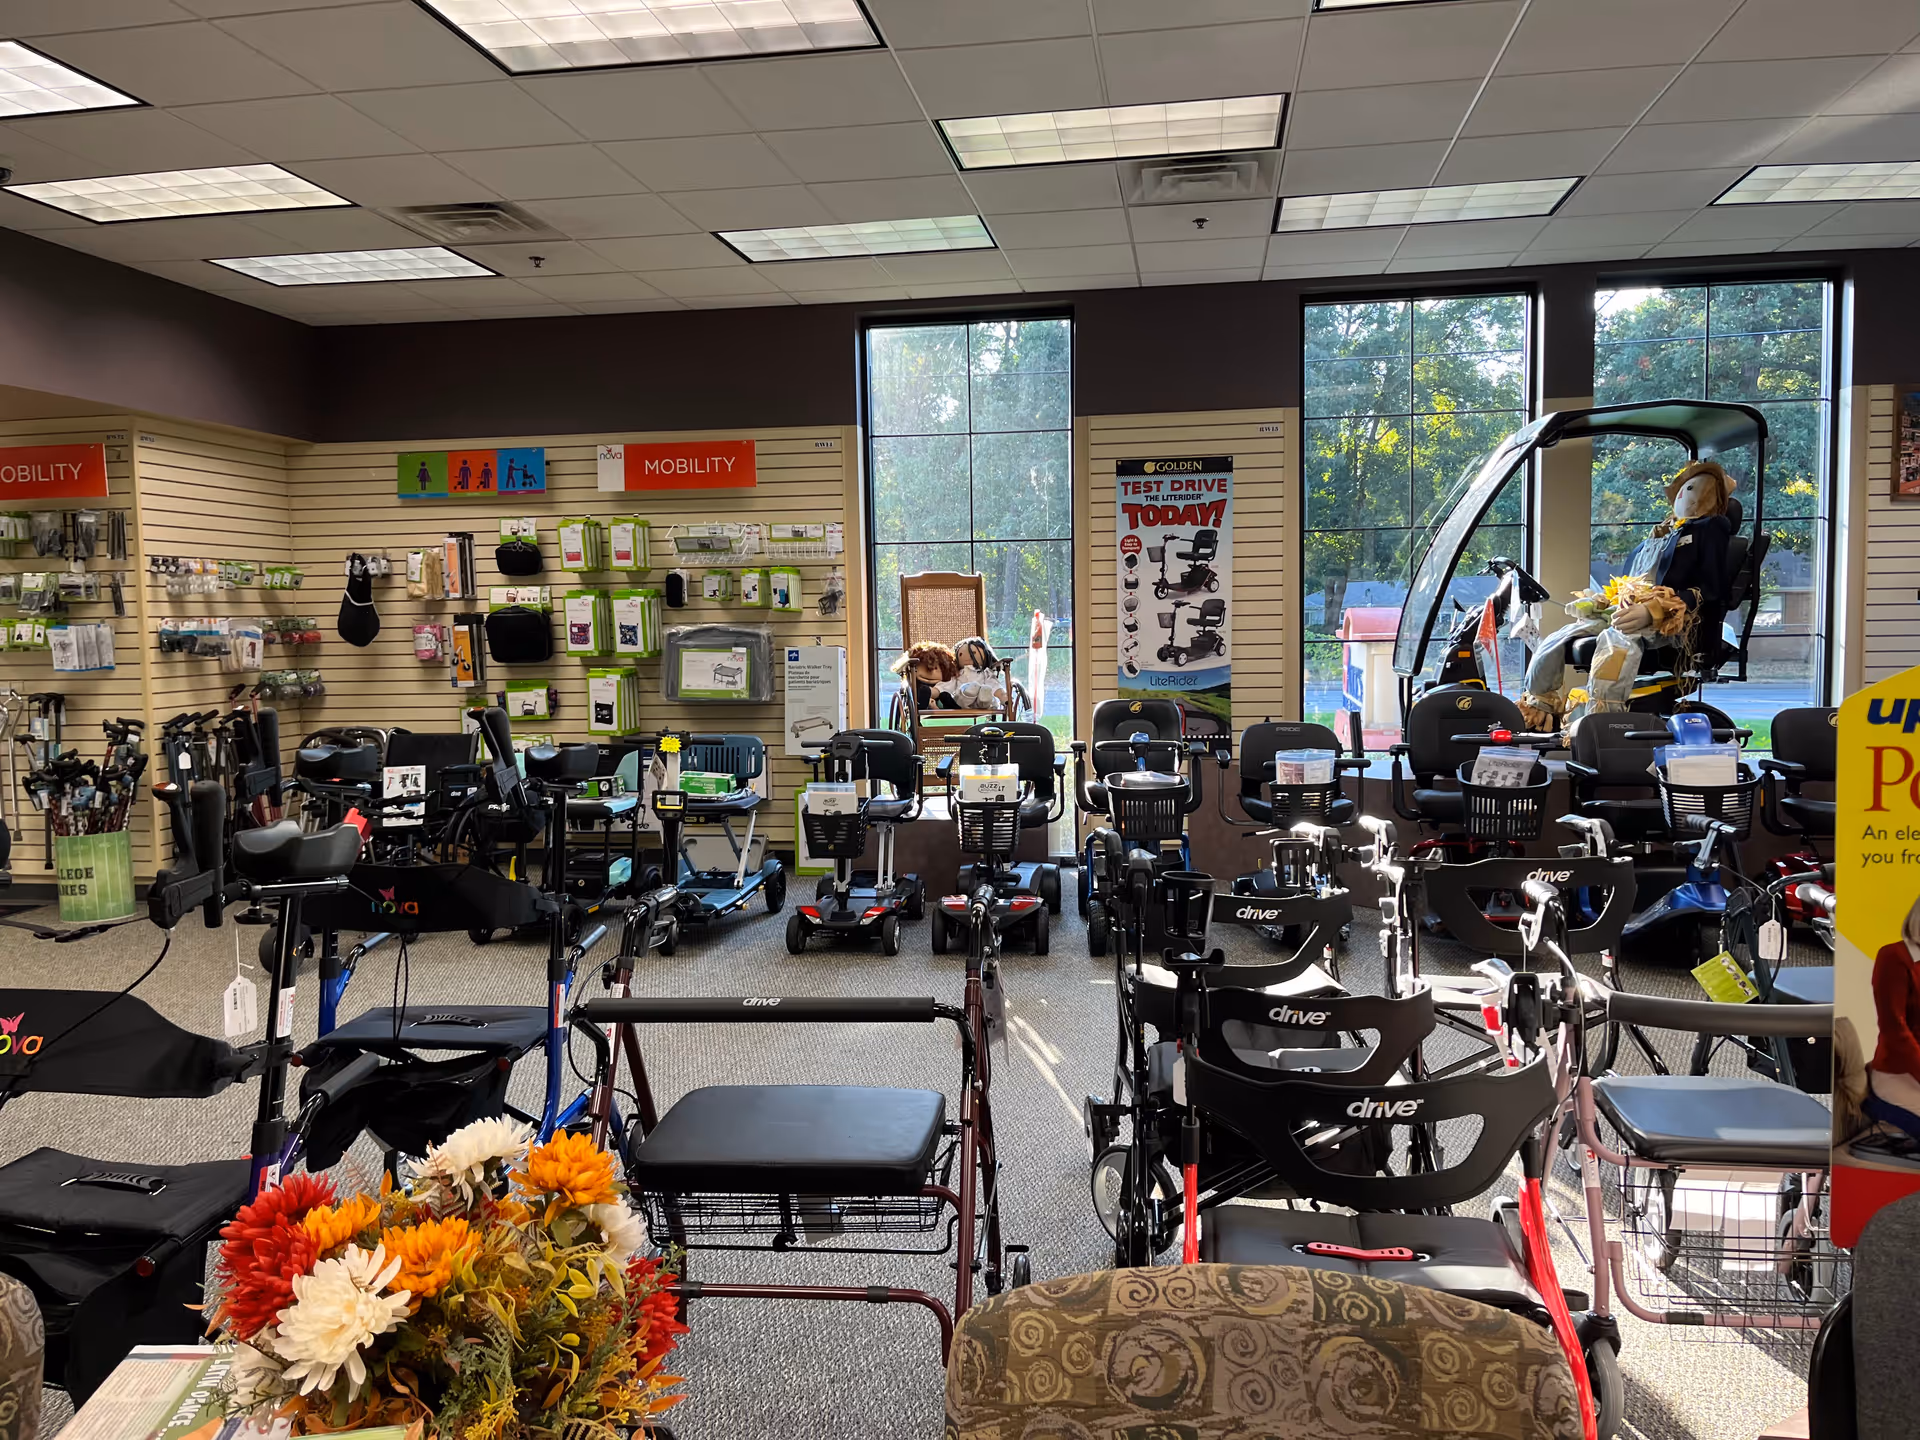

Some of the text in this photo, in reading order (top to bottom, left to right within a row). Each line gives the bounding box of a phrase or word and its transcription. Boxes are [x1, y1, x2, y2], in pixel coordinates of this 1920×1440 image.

[600, 451, 622, 460] nova
[0, 463, 82, 483] OBILITY
[645, 456, 735, 475] MOBILITY
[1156, 460, 1202, 472] GOLDEN
[1121, 478, 1228, 496] TEST DRIVE
[1121, 498, 1228, 530] TODAY!
[1150, 675, 1198, 687] LiteRider
[1864, 746, 1920, 812] P
[1862, 825, 1888, 840] An
[1861, 852, 1894, 868] you
[57, 866, 94, 881] LEGE
[1526, 867, 1572, 883] drive
[371, 900, 419, 915] nova
[1235, 905, 1280, 920] drive
[742, 996, 781, 1007] drive
[1268, 1004, 1328, 1025] drive
[0, 1034, 44, 1055] ova
[1346, 1096, 1420, 1119] drive
